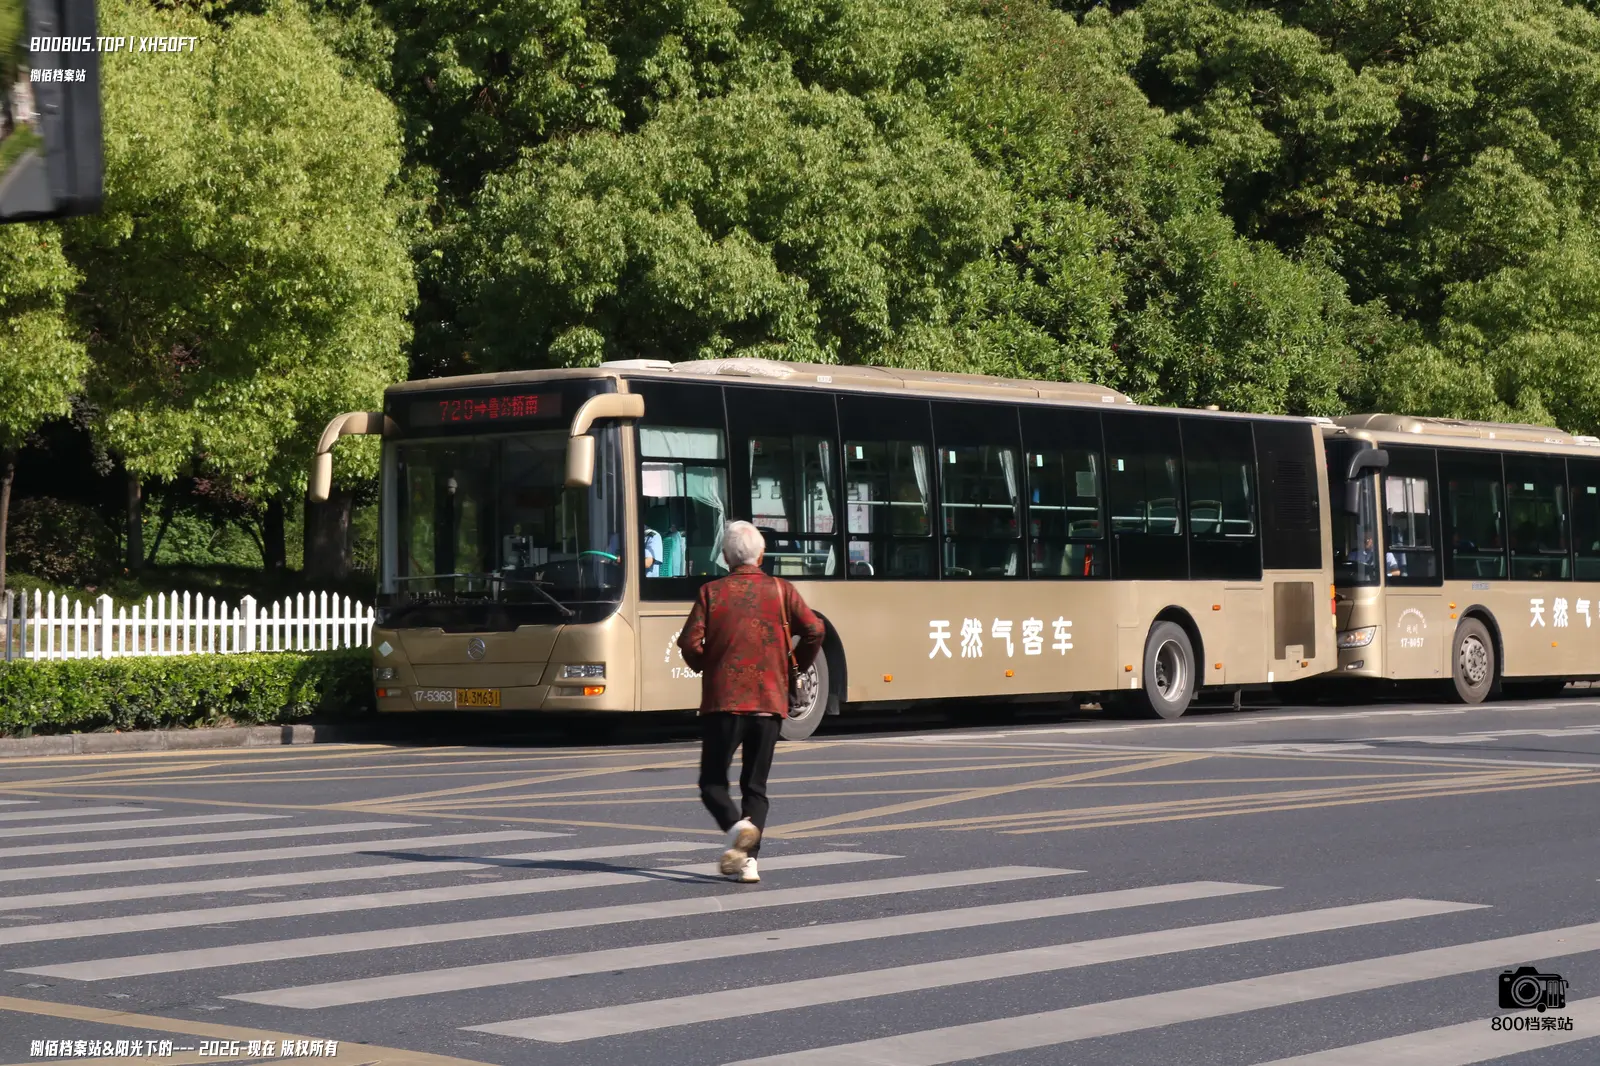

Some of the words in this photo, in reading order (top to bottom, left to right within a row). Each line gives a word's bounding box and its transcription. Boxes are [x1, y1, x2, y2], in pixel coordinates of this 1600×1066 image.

[1530, 597, 1600, 629] 天然气
[928, 615, 1074, 660] 天然气客车
[414, 690, 453, 702] 17-5363
